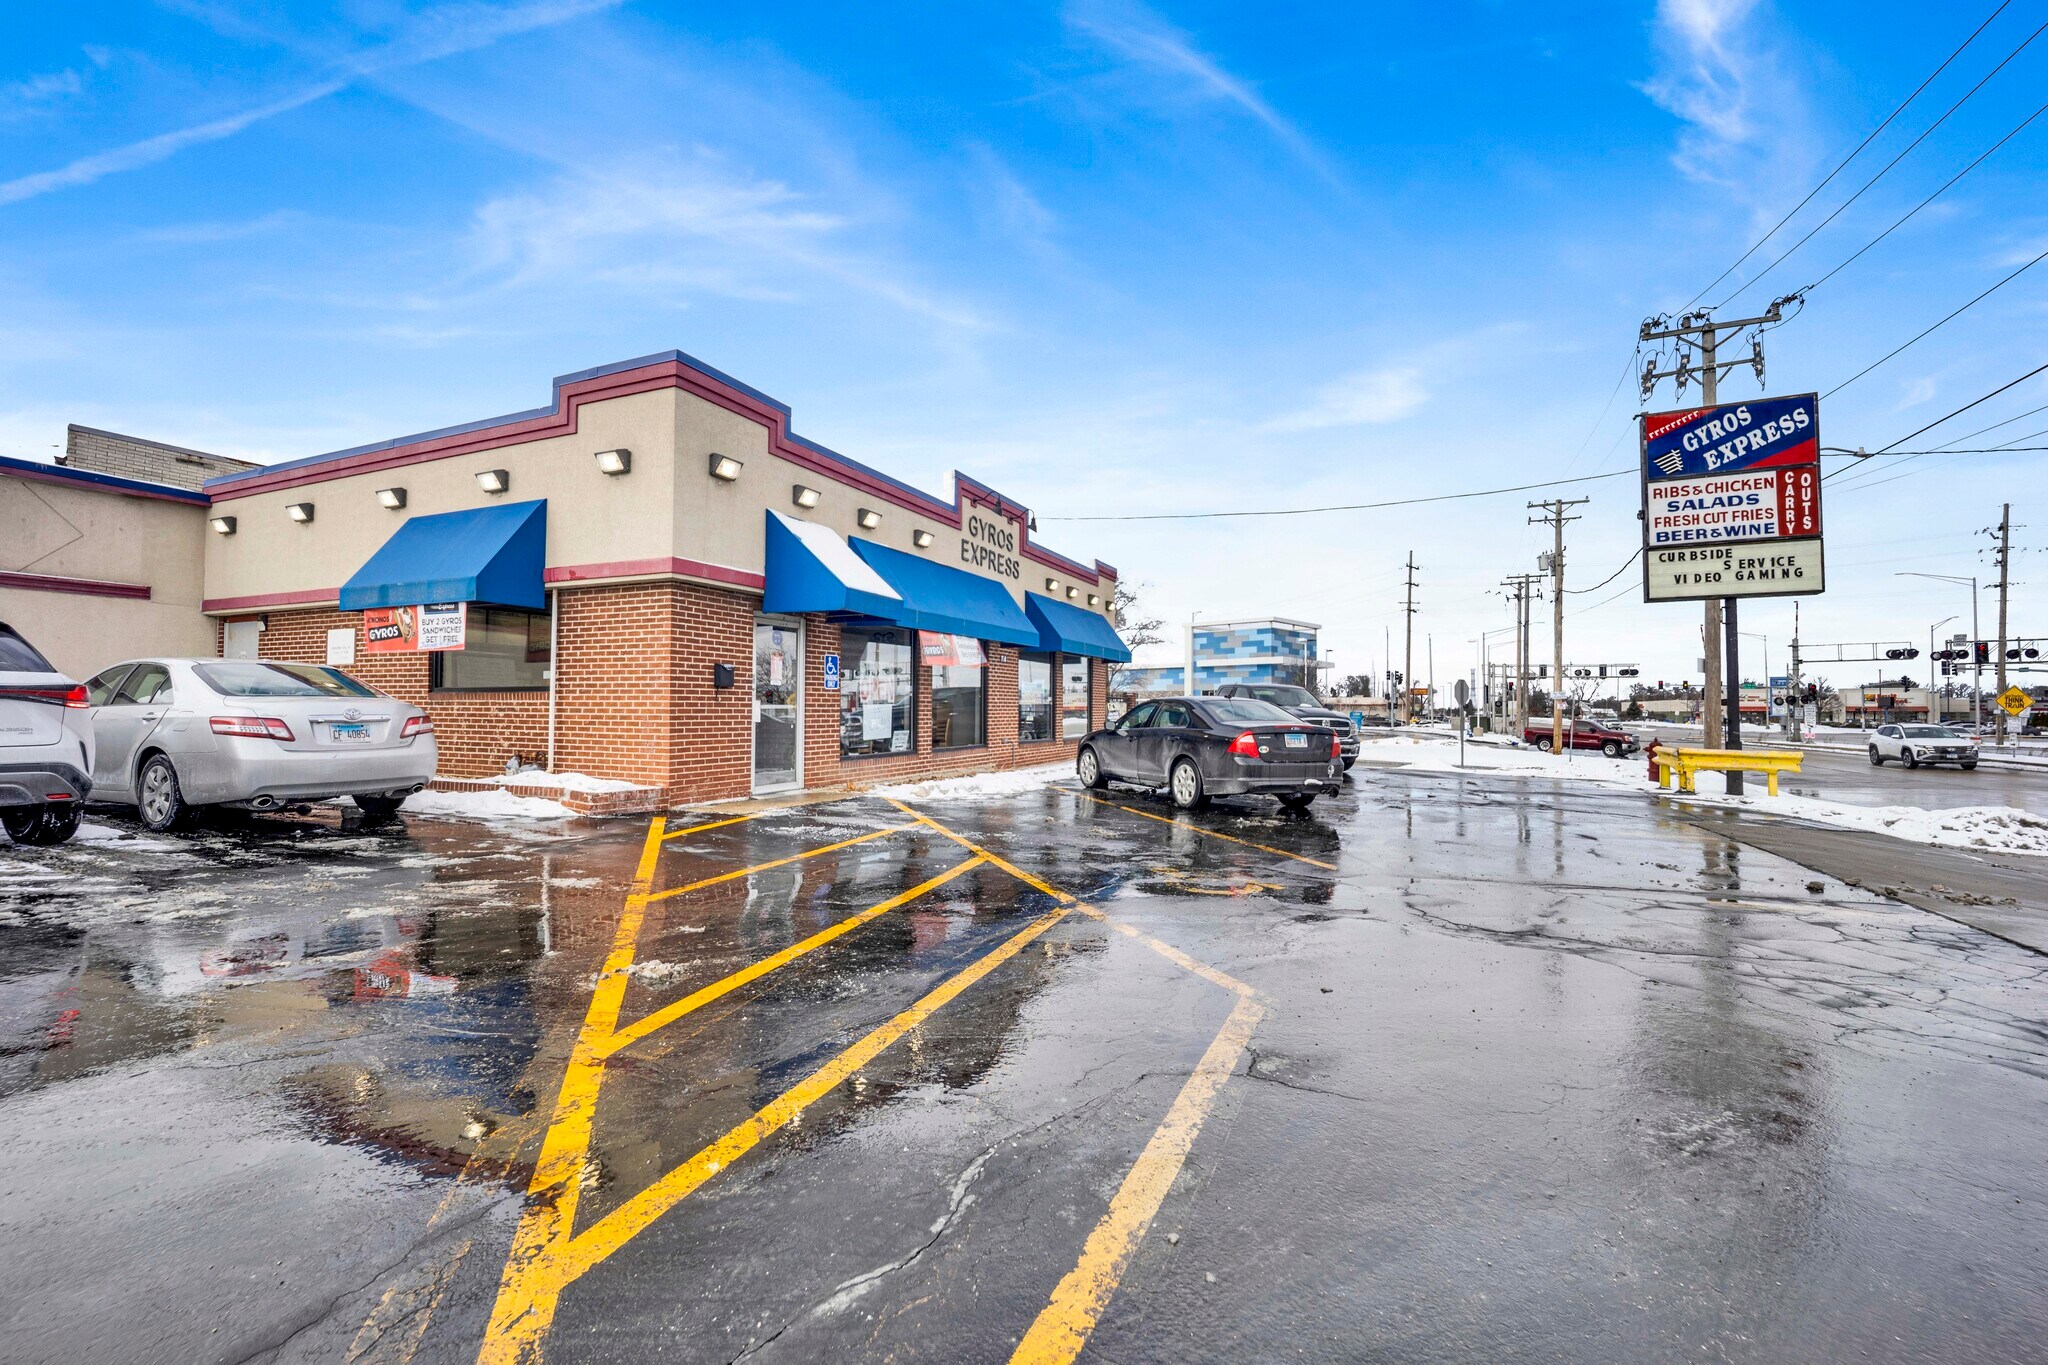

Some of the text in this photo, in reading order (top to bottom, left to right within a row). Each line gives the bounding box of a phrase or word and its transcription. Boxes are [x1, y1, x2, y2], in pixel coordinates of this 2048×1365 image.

[1682, 405, 1752, 452] GYROS
[1702, 407, 1810, 471] EXPRESS
[1667, 493, 1760, 512] SALADS
[1784, 471, 1796, 534] CARRY
[1800, 473, 1812, 530] OUTS
[1654, 507, 1774, 528] FRESH CUT FRIES
[968, 515, 1014, 553] GYROS
[961, 538, 1020, 580] EXPRESS
[1658, 548, 1733, 563] CURBSIDE
[1674, 567, 1804, 584] VIDEO GAMING
[422, 616, 462, 626] BUY 2 GYROS
[423, 626, 462, 634] SANDWICHES
[369, 626, 399, 640] GYROS
[426, 635, 437, 643] GET
[443, 635, 458, 643] FREE
[333, 729, 370, 740] CF 40854
